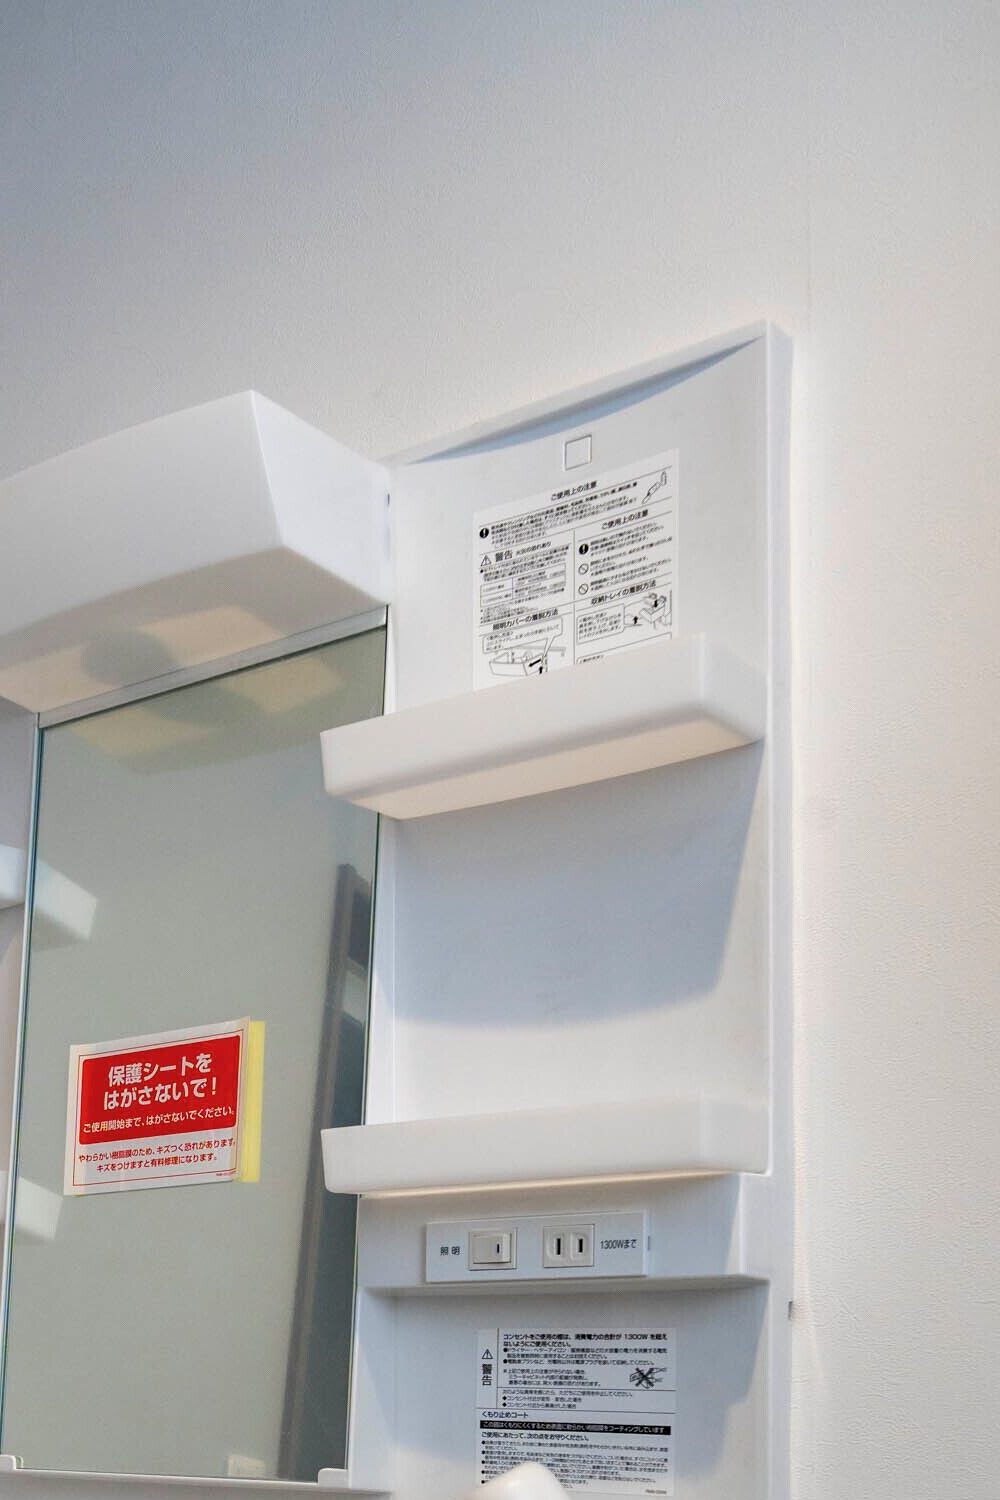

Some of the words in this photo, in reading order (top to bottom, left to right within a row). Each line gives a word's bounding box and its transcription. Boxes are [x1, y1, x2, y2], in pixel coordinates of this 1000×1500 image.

[550, 481, 597, 501] ご使用上の注意
[601, 509, 649, 530] ご使用上の注意
[107, 1052, 212, 1087] 保護シートを
[103, 1077, 217, 1110] はがさないで！
[83, 1105, 235, 1133] ご使用開始まで、はがさないでください。
[96, 1152, 218, 1173] キズをつけますと有料修理になります。
[600, 1239, 637, 1250] 1300Wまで
[481, 1411, 529, 1419] くもり止めコート
